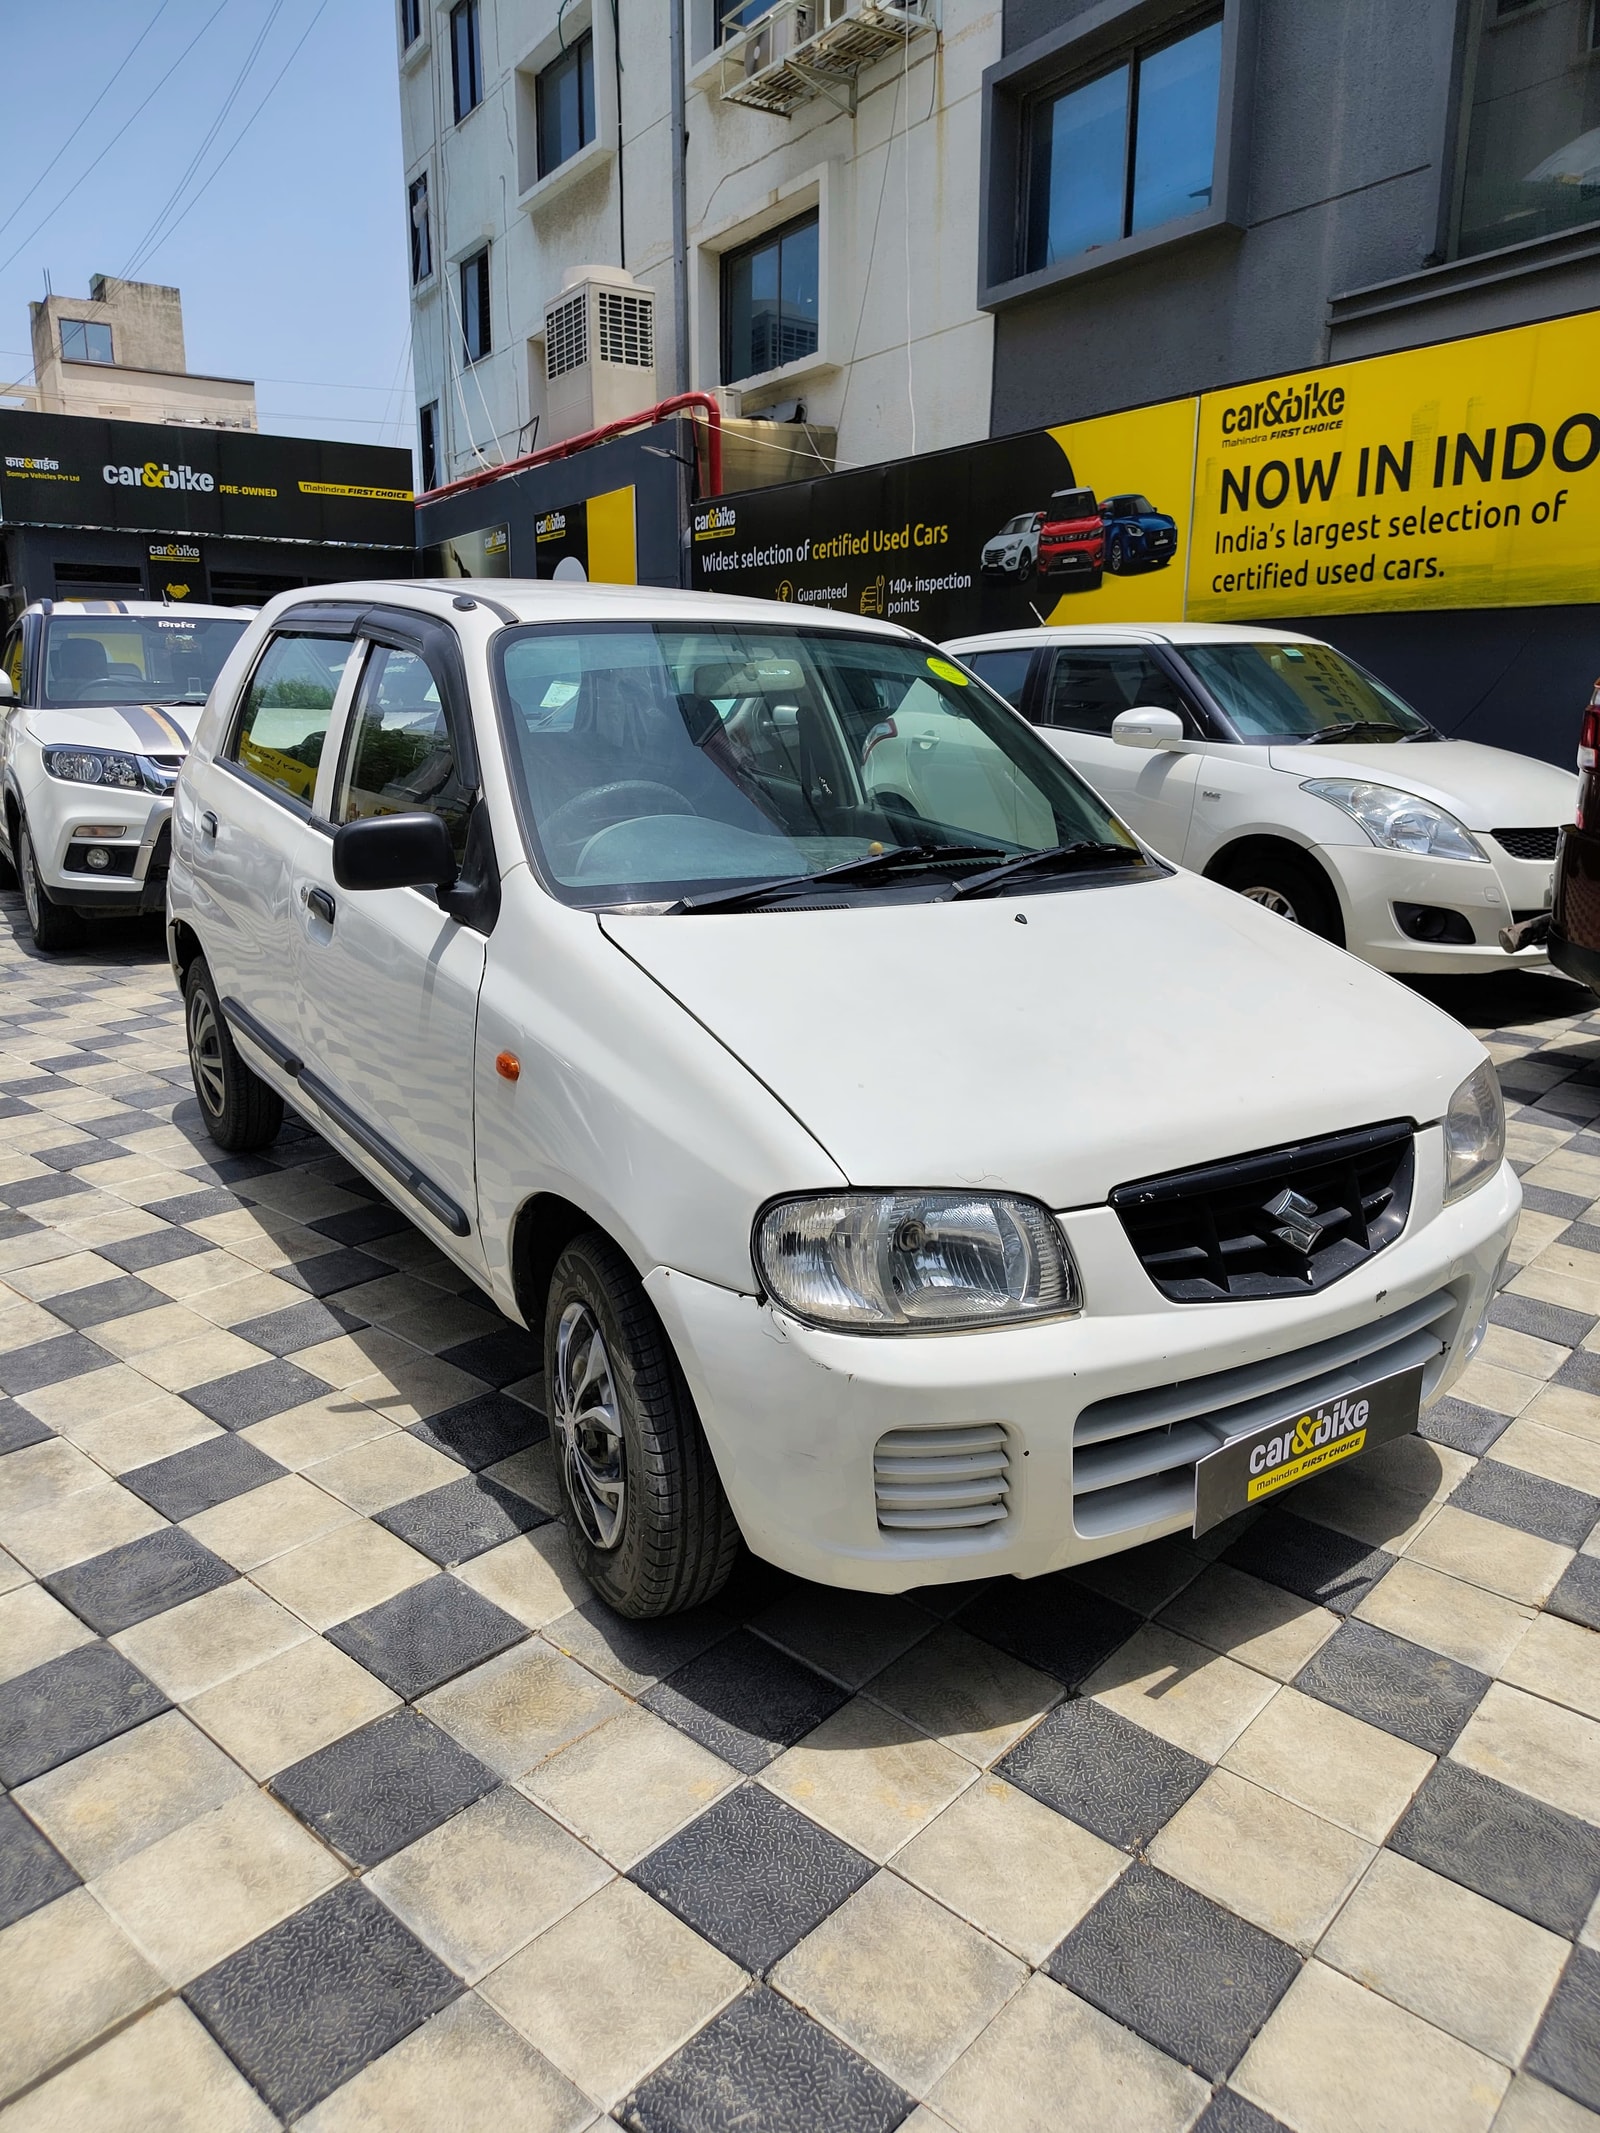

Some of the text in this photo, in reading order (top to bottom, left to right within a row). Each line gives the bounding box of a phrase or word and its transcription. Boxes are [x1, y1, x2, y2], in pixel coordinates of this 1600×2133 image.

[1221, 382, 1345, 434] car&bike
[1221, 419, 1344, 449] Mahindra FIRST CHOICE
[30, 472, 57, 480] Vehicles
[102, 462, 278, 498] car&bike PRE-OWNED
[303, 483, 408, 499] Mahindra FIRST CHOICE
[1219, 451, 1342, 515] NOW
[1356, 440, 1414, 498] IN
[694, 506, 736, 531] car&bike
[1215, 490, 1569, 555] India's largest selection of
[149, 544, 200, 557] car&bike
[702, 523, 949, 573] Widest selection of certified Used Cars
[888, 572, 971, 595] 140+ inspection
[1211, 554, 1446, 594] certified used cars.
[797, 582, 848, 602] Guaranteed
[887, 598, 920, 618] points
[1249, 1398, 1370, 1475] car&bike
[1256, 1437, 1361, 1492] Mahindra FIRST CHOICE
